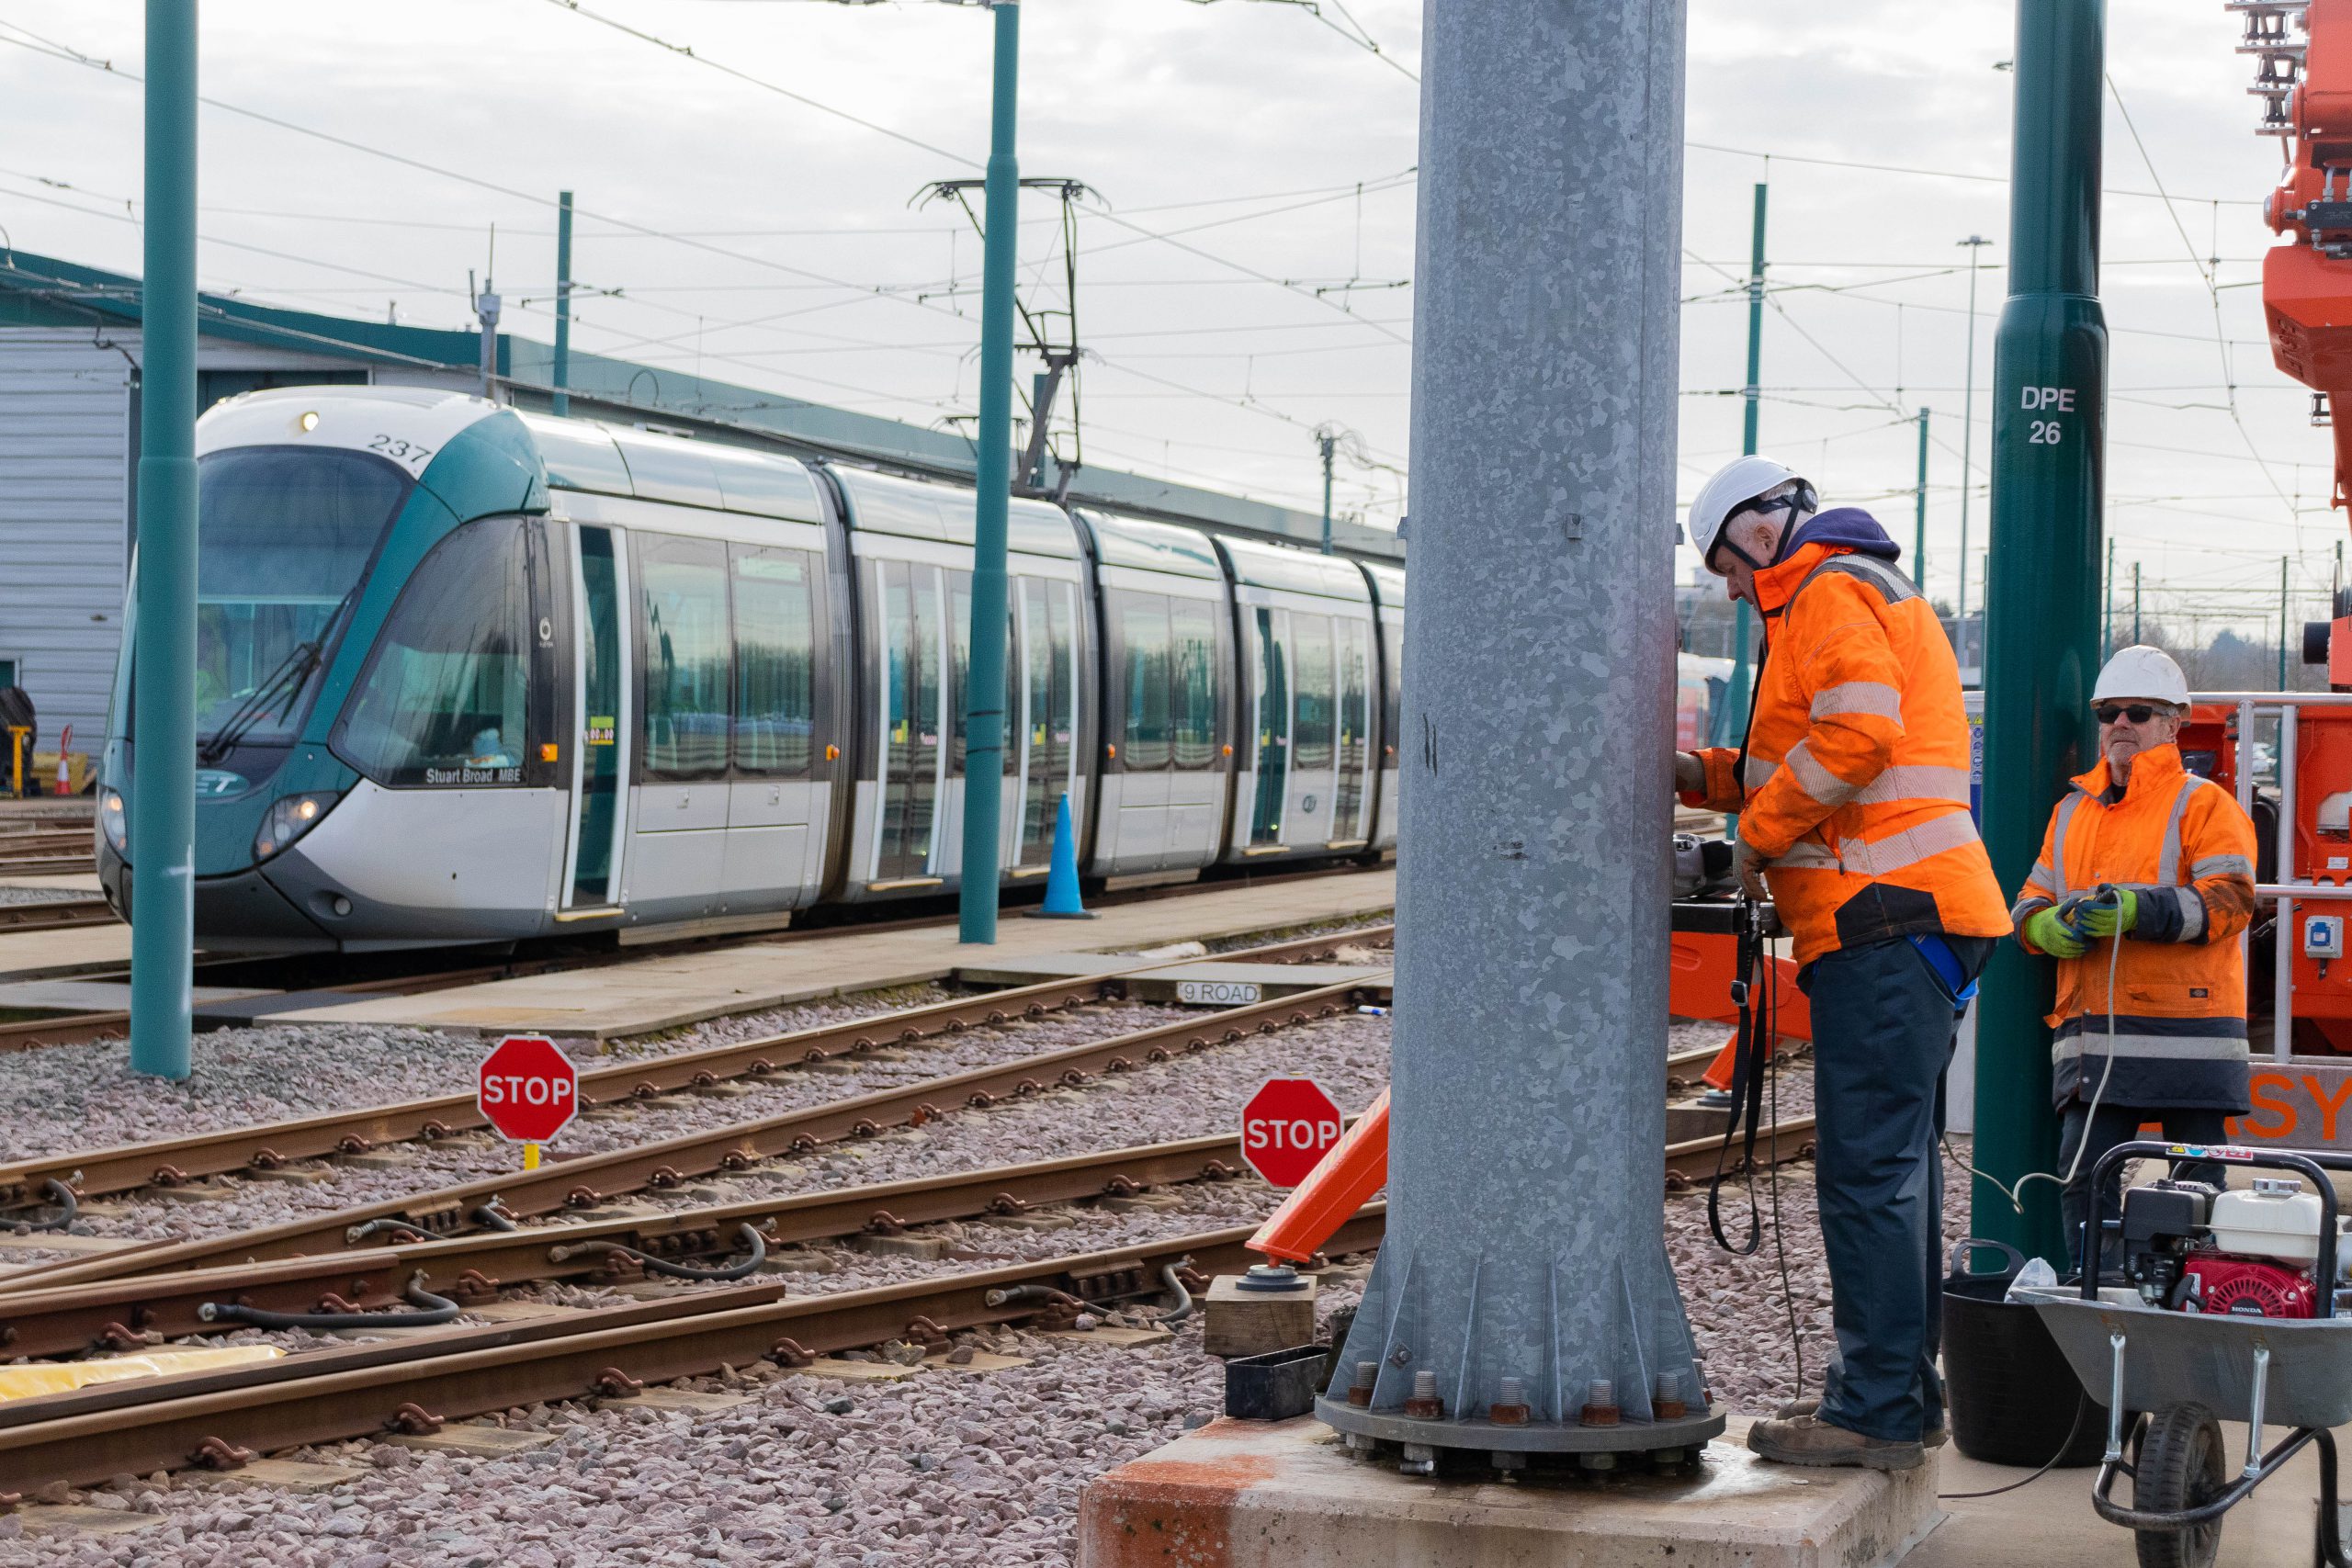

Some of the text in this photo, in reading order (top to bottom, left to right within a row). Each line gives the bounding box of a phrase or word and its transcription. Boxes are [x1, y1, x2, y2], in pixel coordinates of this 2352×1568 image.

[2021, 387, 2075, 412] DPE
[2029, 420, 2061, 445] 26
[368, 434, 432, 462] 237
[196, 776, 239, 793] ET
[426, 768, 521, 784] Stuart Broad MBE
[1184, 984, 1258, 1001] 9 ROAD
[484, 1075, 571, 1106] STOP
[1248, 1119, 1338, 1150] STOP
